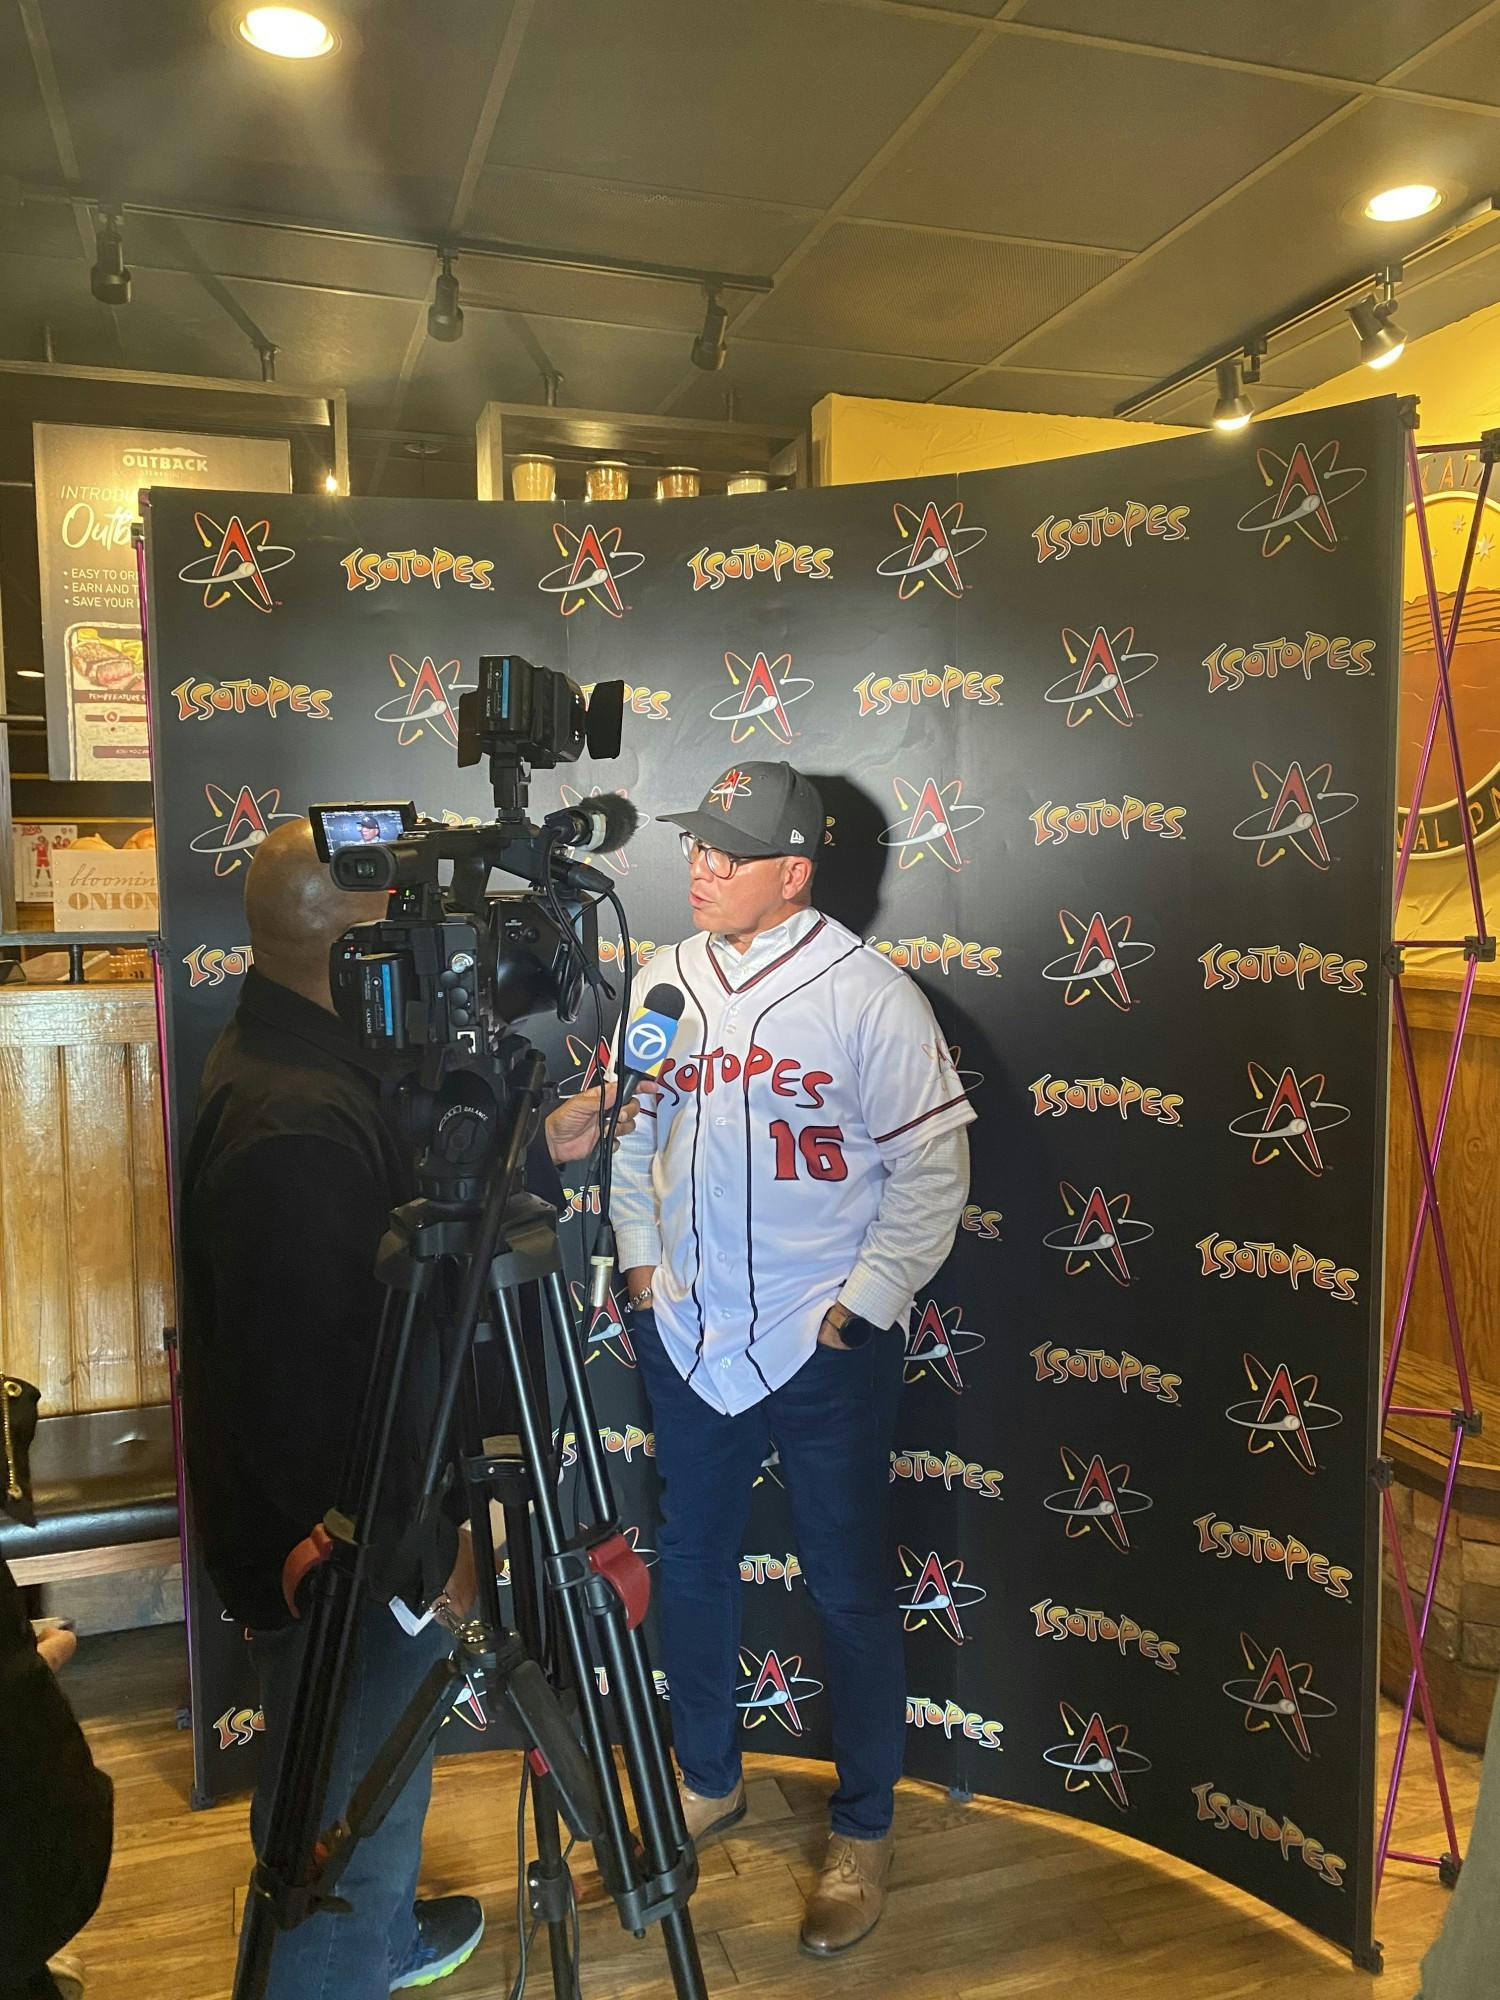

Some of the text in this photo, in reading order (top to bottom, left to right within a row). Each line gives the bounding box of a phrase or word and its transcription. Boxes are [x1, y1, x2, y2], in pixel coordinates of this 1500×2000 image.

[122, 454, 208, 472] OUTBACK
[1032, 500, 1191, 563] ISOTOPES
[71, 568, 100, 579] EASY
[102, 569, 117, 580] TO
[72, 582, 103, 593] EARN
[106, 584, 129, 594] AND
[340, 546, 494, 592] ISOTOPES
[687, 539, 834, 592] ISOTOPES
[72, 597, 134, 608] SAVE YOUR
[1200, 631, 1377, 694] ISOTOPES
[171, 675, 333, 721] ISOTOPES
[853, 664, 1004, 717] ISOTOPES
[1028, 795, 1187, 845] ISOTOPES
[1198, 942, 1368, 994] ISOTOPES
[656, 1043, 834, 1110] SOTOPES
[1028, 1073, 1183, 1125] ISOTOPES
[768, 1118, 849, 1182] 16
[1195, 1231, 1360, 1301] ISOTOPES
[1030, 1340, 1182, 1405] ISOTOPES
[1193, 1511, 1352, 1601] ISOTOPES
[1030, 1598, 1180, 1673] ISOTOPES
[1191, 1781, 1347, 1887] ISOTOPES
